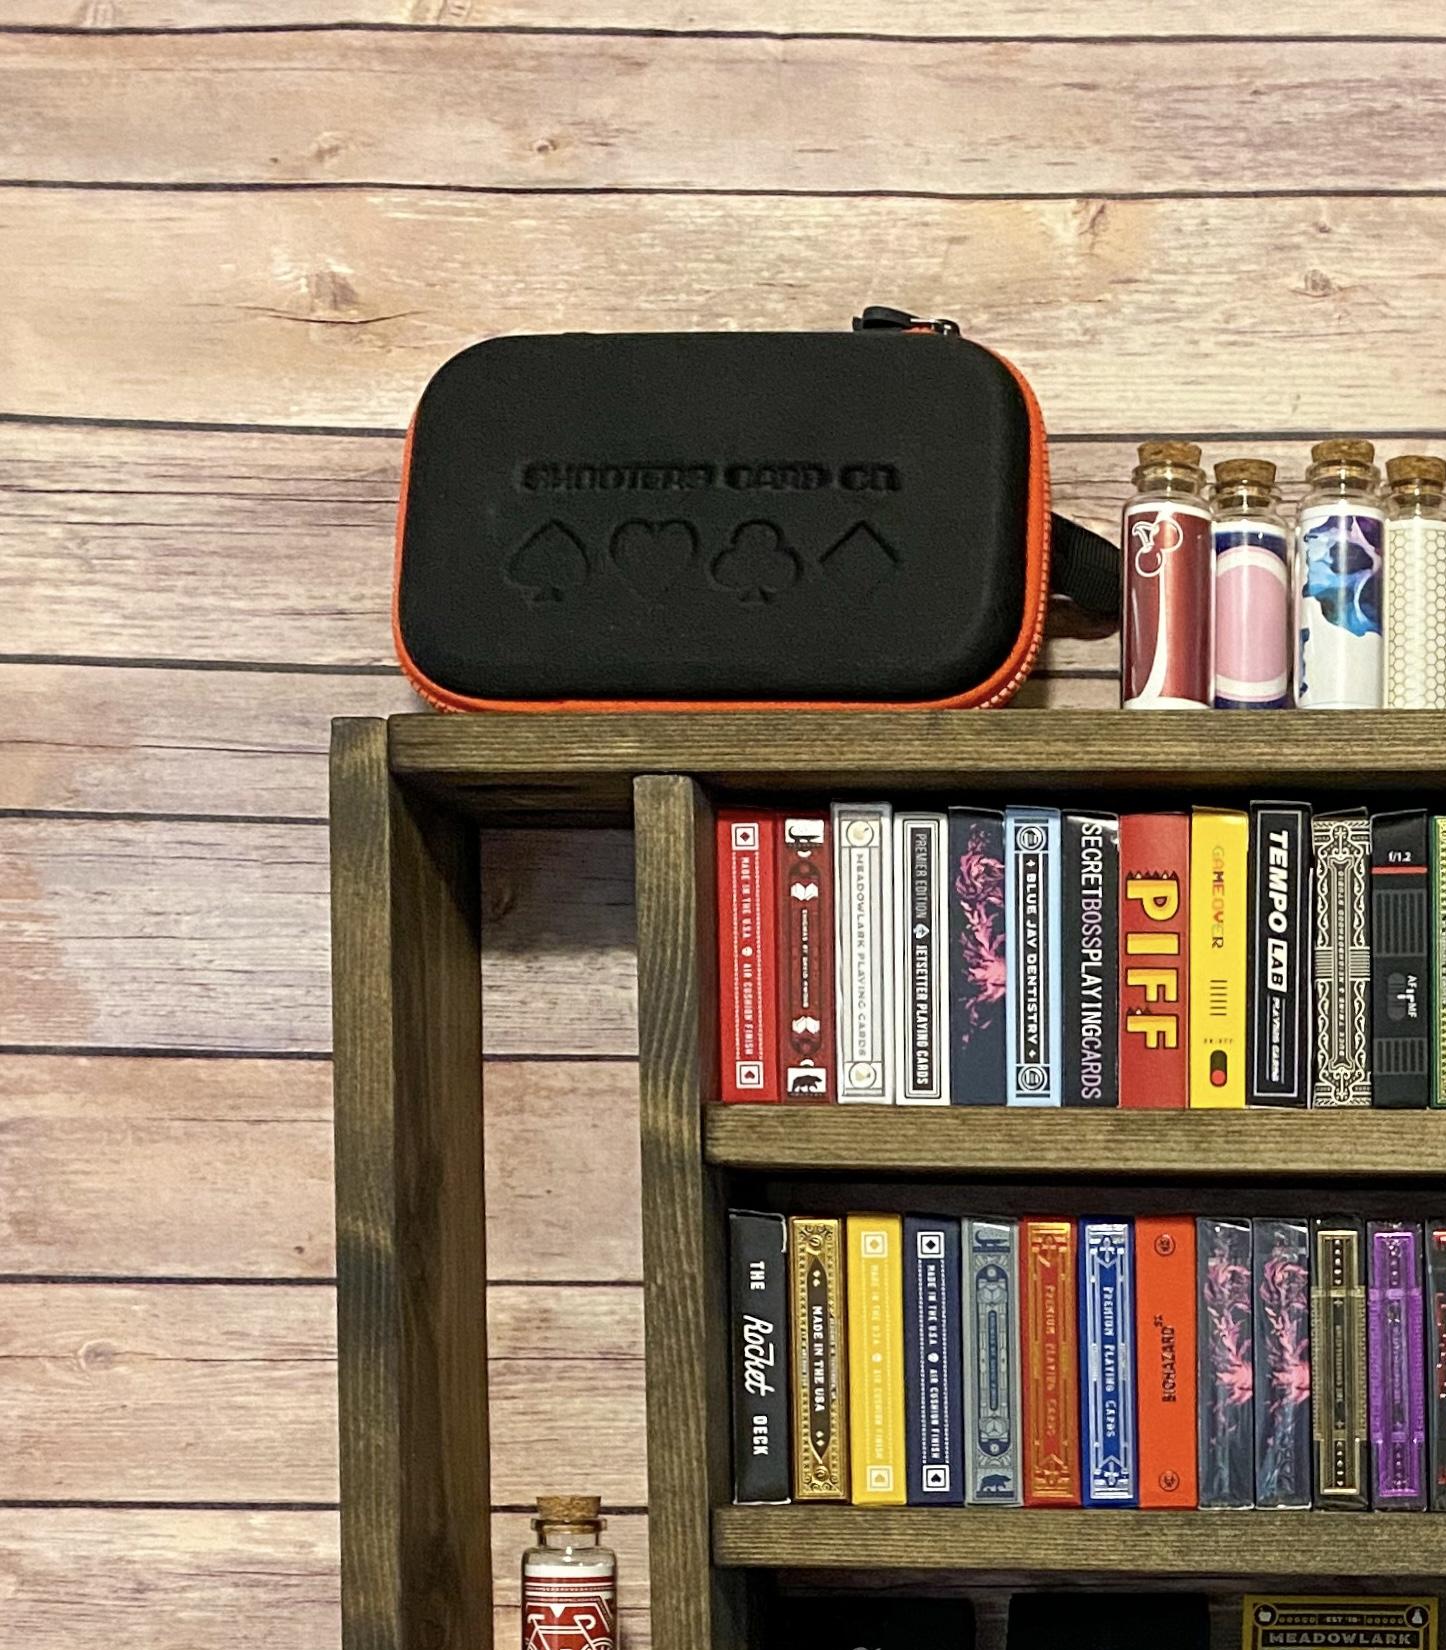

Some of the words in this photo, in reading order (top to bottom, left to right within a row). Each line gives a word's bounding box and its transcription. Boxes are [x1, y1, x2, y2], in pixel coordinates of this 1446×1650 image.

[520, 461, 716, 492] SHOOTERS
[724, 461, 833, 491] CARD
[915, 833, 927, 876] PREMIER
[916, 880, 927, 918] EDITION
[1026, 873, 1037, 915] BLUE
[1268, 830, 1288, 932] TEMPO
[857, 854, 865, 948] MEADOWLARK
[1026, 920, 1037, 947] JAY
[916, 945, 927, 1000] JETSETTER
[1126, 877, 1180, 1049] PIFF
[1272, 943, 1282, 985] LAB
[1027, 954, 1037, 1044] DENTISTRY
[916, 1004, 927, 1047] PLAYING
[917, 1051, 928, 1084] CARDS
[751, 1261, 765, 1290] THE
[813, 1306, 823, 1340] MADE
[1103, 1287, 1114, 1335] PREMIUM
[744, 1315, 774, 1395] Rocket
[814, 1344, 823, 1356] IN
[1104, 1345, 1115, 1391] PLAYING
[814, 1360, 823, 1383] THE
[930, 1369, 939, 1383] AIR
[814, 1388, 825, 1411] USA
[930, 1387, 939, 1425] CUSHION
[753, 1416, 768, 1455] DECK
[1106, 1401, 1116, 1437] CARDS
[931, 1428, 940, 1459] FINISH
[1269, 1633, 1412, 1645] MEADOWLARK
